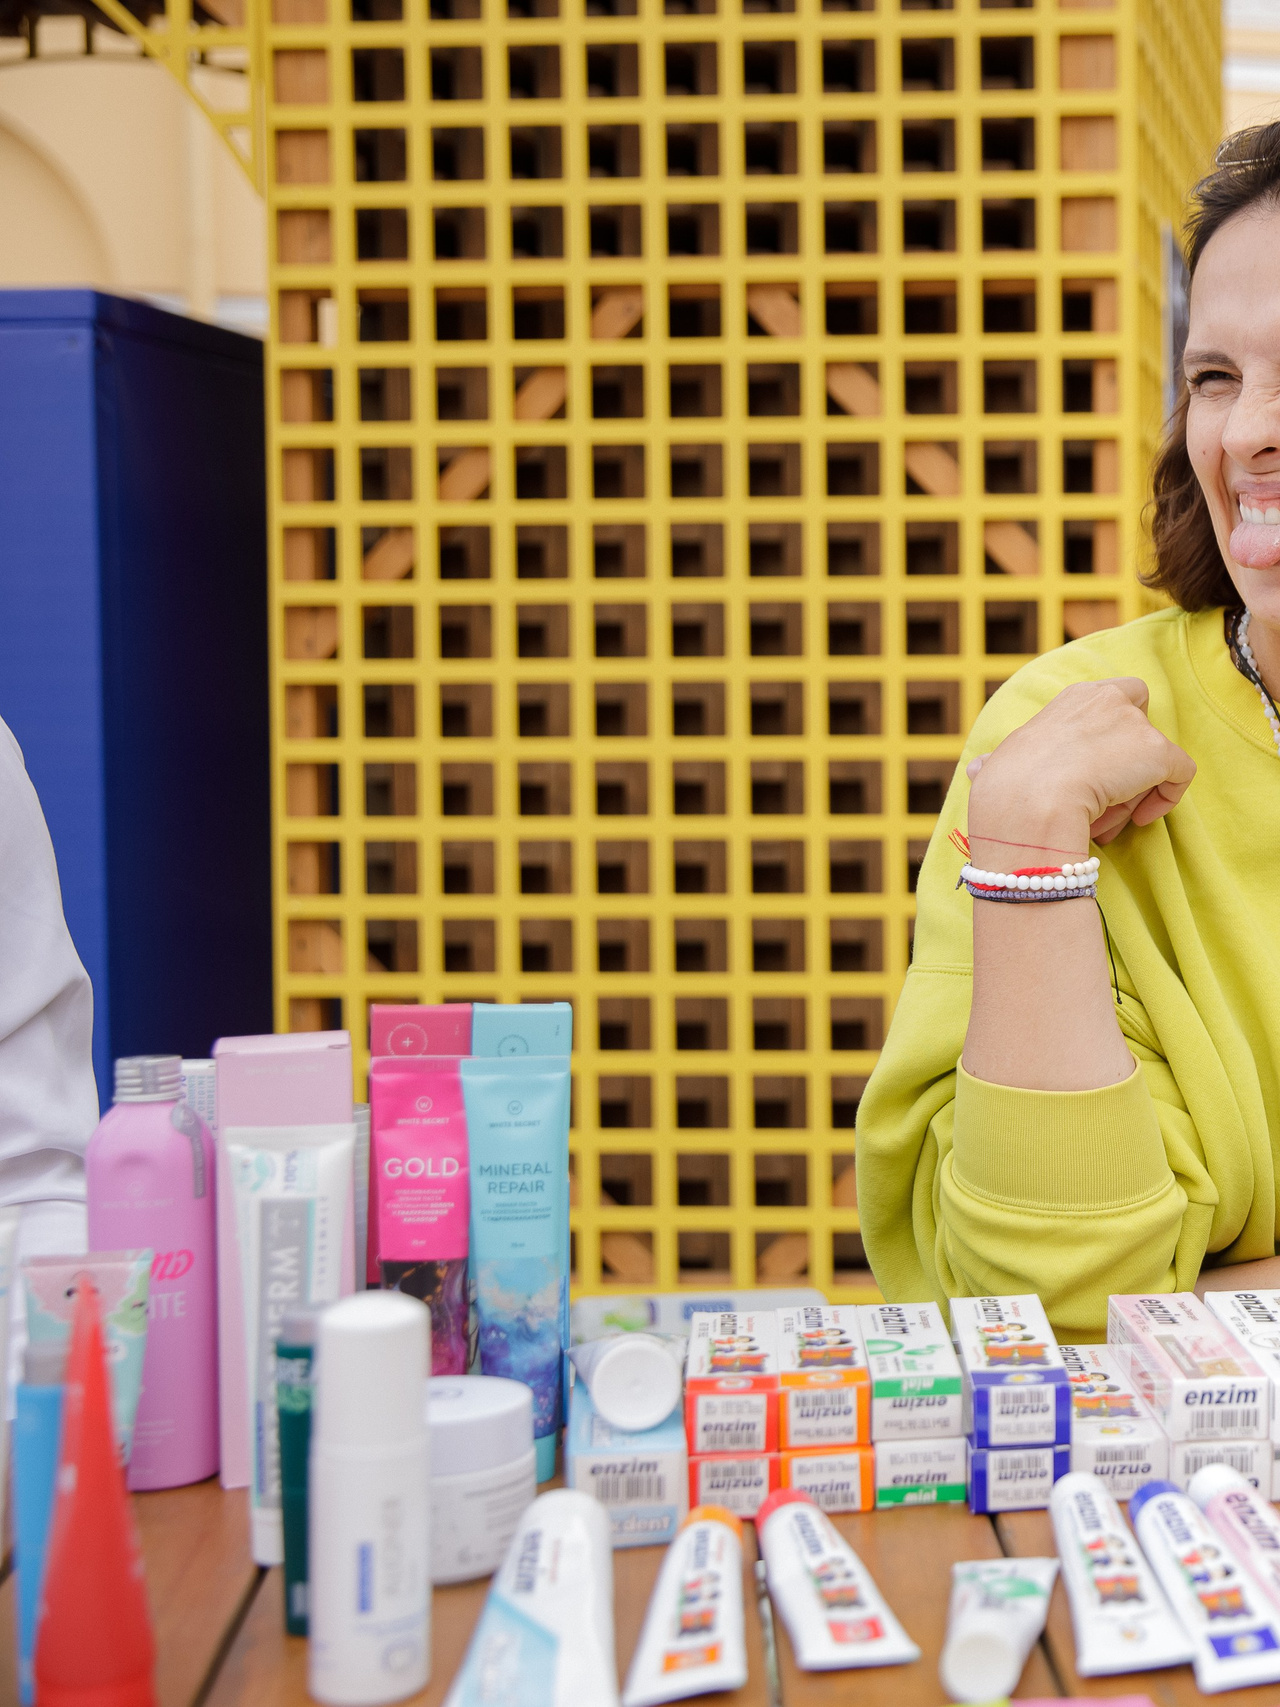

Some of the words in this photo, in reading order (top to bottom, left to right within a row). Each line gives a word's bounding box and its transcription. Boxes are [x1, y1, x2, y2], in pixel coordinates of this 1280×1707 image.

[207, 1075, 215, 1121] NATURELLE
[284, 1151, 298, 1191] 100%
[384, 1157, 460, 1178] GOLD
[479, 1162, 553, 1176] MINERAL
[488, 1180, 545, 1194] REPAIR
[980, 1298, 1010, 1322] enzim
[1139, 1299, 1180, 1324] enzim
[1234, 1293, 1278, 1322] enzim
[879, 1306, 916, 1335] enzim
[1059, 1346, 1089, 1372] enzim
[890, 1397, 949, 1411] enzim
[1185, 1384, 1258, 1406] enzim
[799, 1406, 854, 1420] enzim
[1000, 1403, 1050, 1418] enzim
[702, 1417, 757, 1432] enzim
[590, 1457, 659, 1476] enzim
[998, 1468, 1048, 1482] enzim
[1093, 1462, 1152, 1478] enzim
[709, 1477, 764, 1491] enzim
[892, 1470, 949, 1485] enzim
[1074, 1491, 1103, 1532] enzim
[1157, 1501, 1193, 1543] enzim
[1226, 1493, 1280, 1550] enzim
